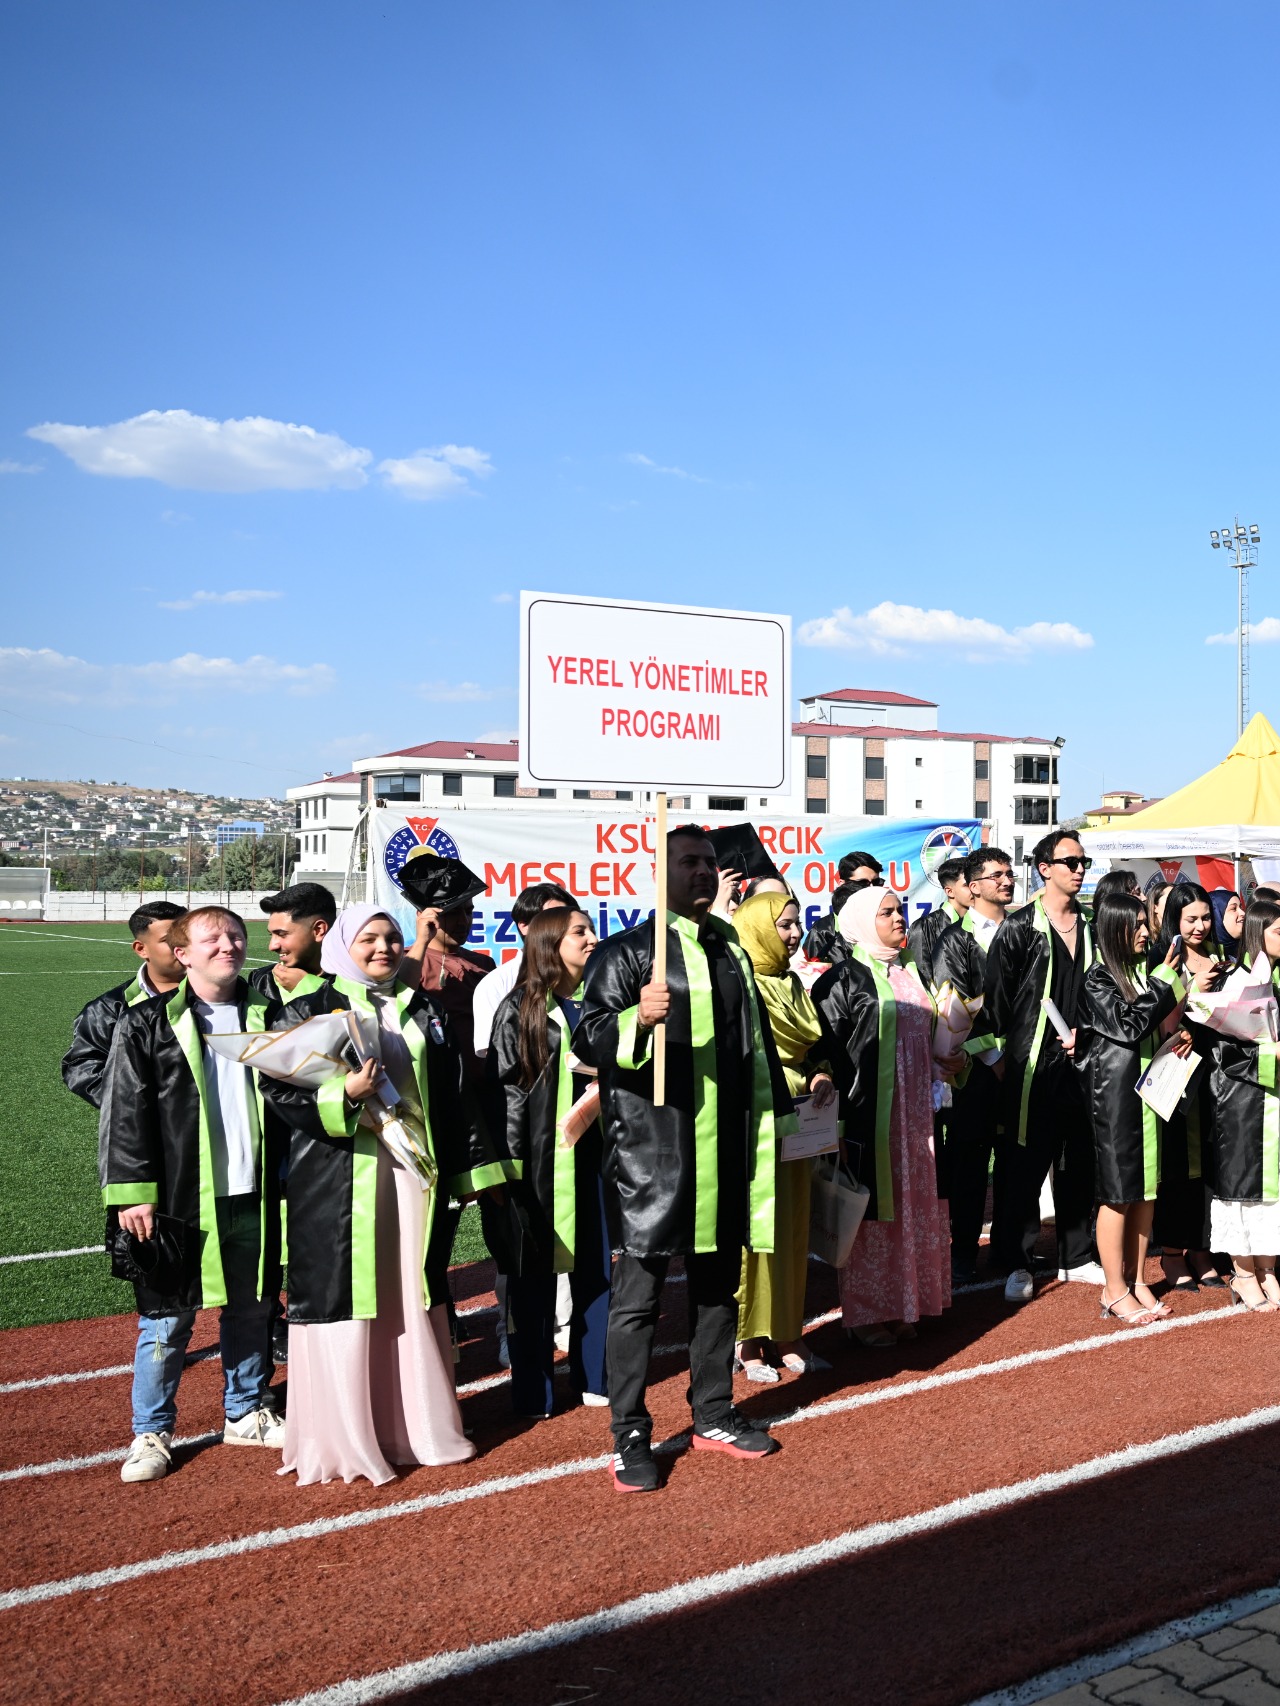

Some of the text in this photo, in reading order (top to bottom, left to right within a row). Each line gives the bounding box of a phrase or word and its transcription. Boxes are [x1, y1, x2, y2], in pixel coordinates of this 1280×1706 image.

[547, 655, 769, 698] YEREL YÖNETİMLER
[602, 707, 720, 741] PROGRAMI
[596, 817, 656, 854] KSÜ
[484, 862, 638, 898] MESLEK
[1164, 868, 1177, 876] T.C.
